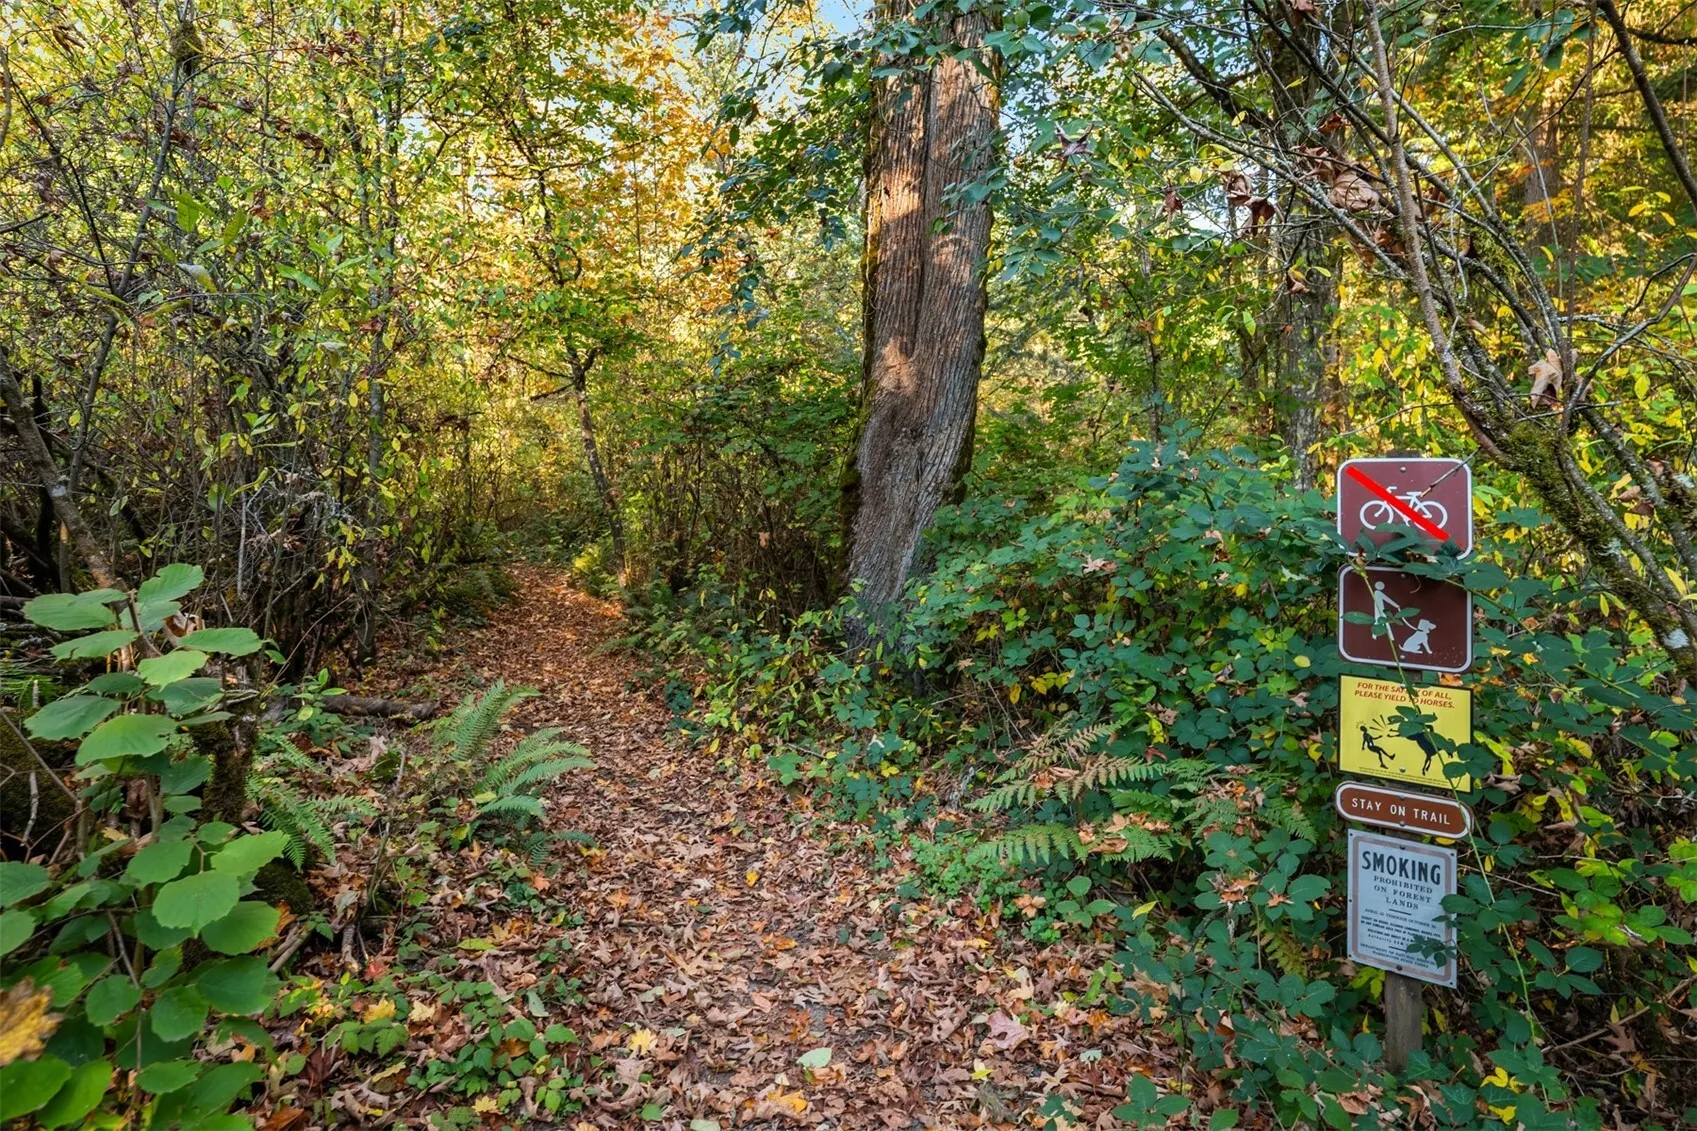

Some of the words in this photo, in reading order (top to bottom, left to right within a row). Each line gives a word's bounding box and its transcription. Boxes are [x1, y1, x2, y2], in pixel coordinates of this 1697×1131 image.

[1355, 690, 1384, 699] PLEASE
[1384, 693, 1406, 702] YIELD
[1420, 698, 1455, 708] HORSES.
[1357, 681, 1373, 690] FOR
[1375, 684, 1389, 692] THE
[1434, 692, 1452, 700] ALL,
[1351, 797, 1382, 812] STAY
[1390, 804, 1406, 817] ON
[1413, 808, 1451, 825] TRAIL
[1362, 850, 1441, 886] SMOKING
[1373, 875, 1433, 894] PROHIBITED
[1374, 884, 1387, 893] ON
[1393, 889, 1432, 904] FOREST
[1386, 896, 1419, 910] LANDS
